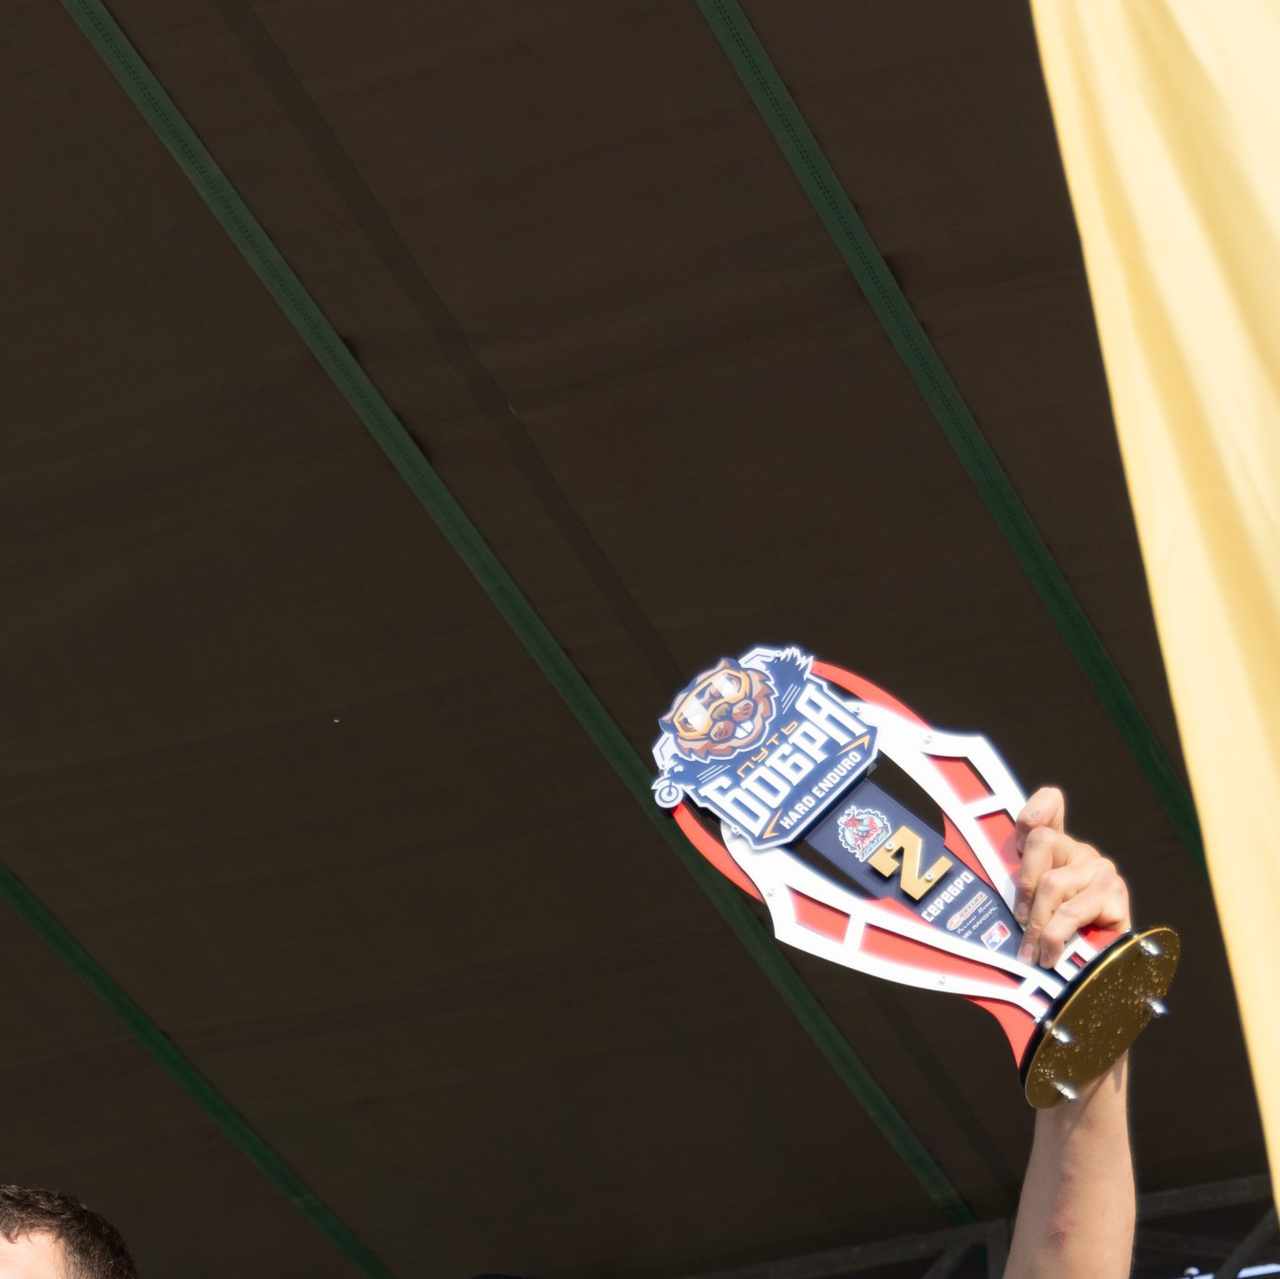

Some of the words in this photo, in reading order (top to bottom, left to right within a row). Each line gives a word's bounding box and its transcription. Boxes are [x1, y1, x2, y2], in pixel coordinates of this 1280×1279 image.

[698, 683, 869, 838] БОБРА
[736, 721, 799, 778] ПУТЬ
[780, 796, 817, 830] HARD
[811, 751, 862, 798] ENDURO
[868, 825, 954, 901] 2
[921, 871, 975, 922] СЕРЕБРО
